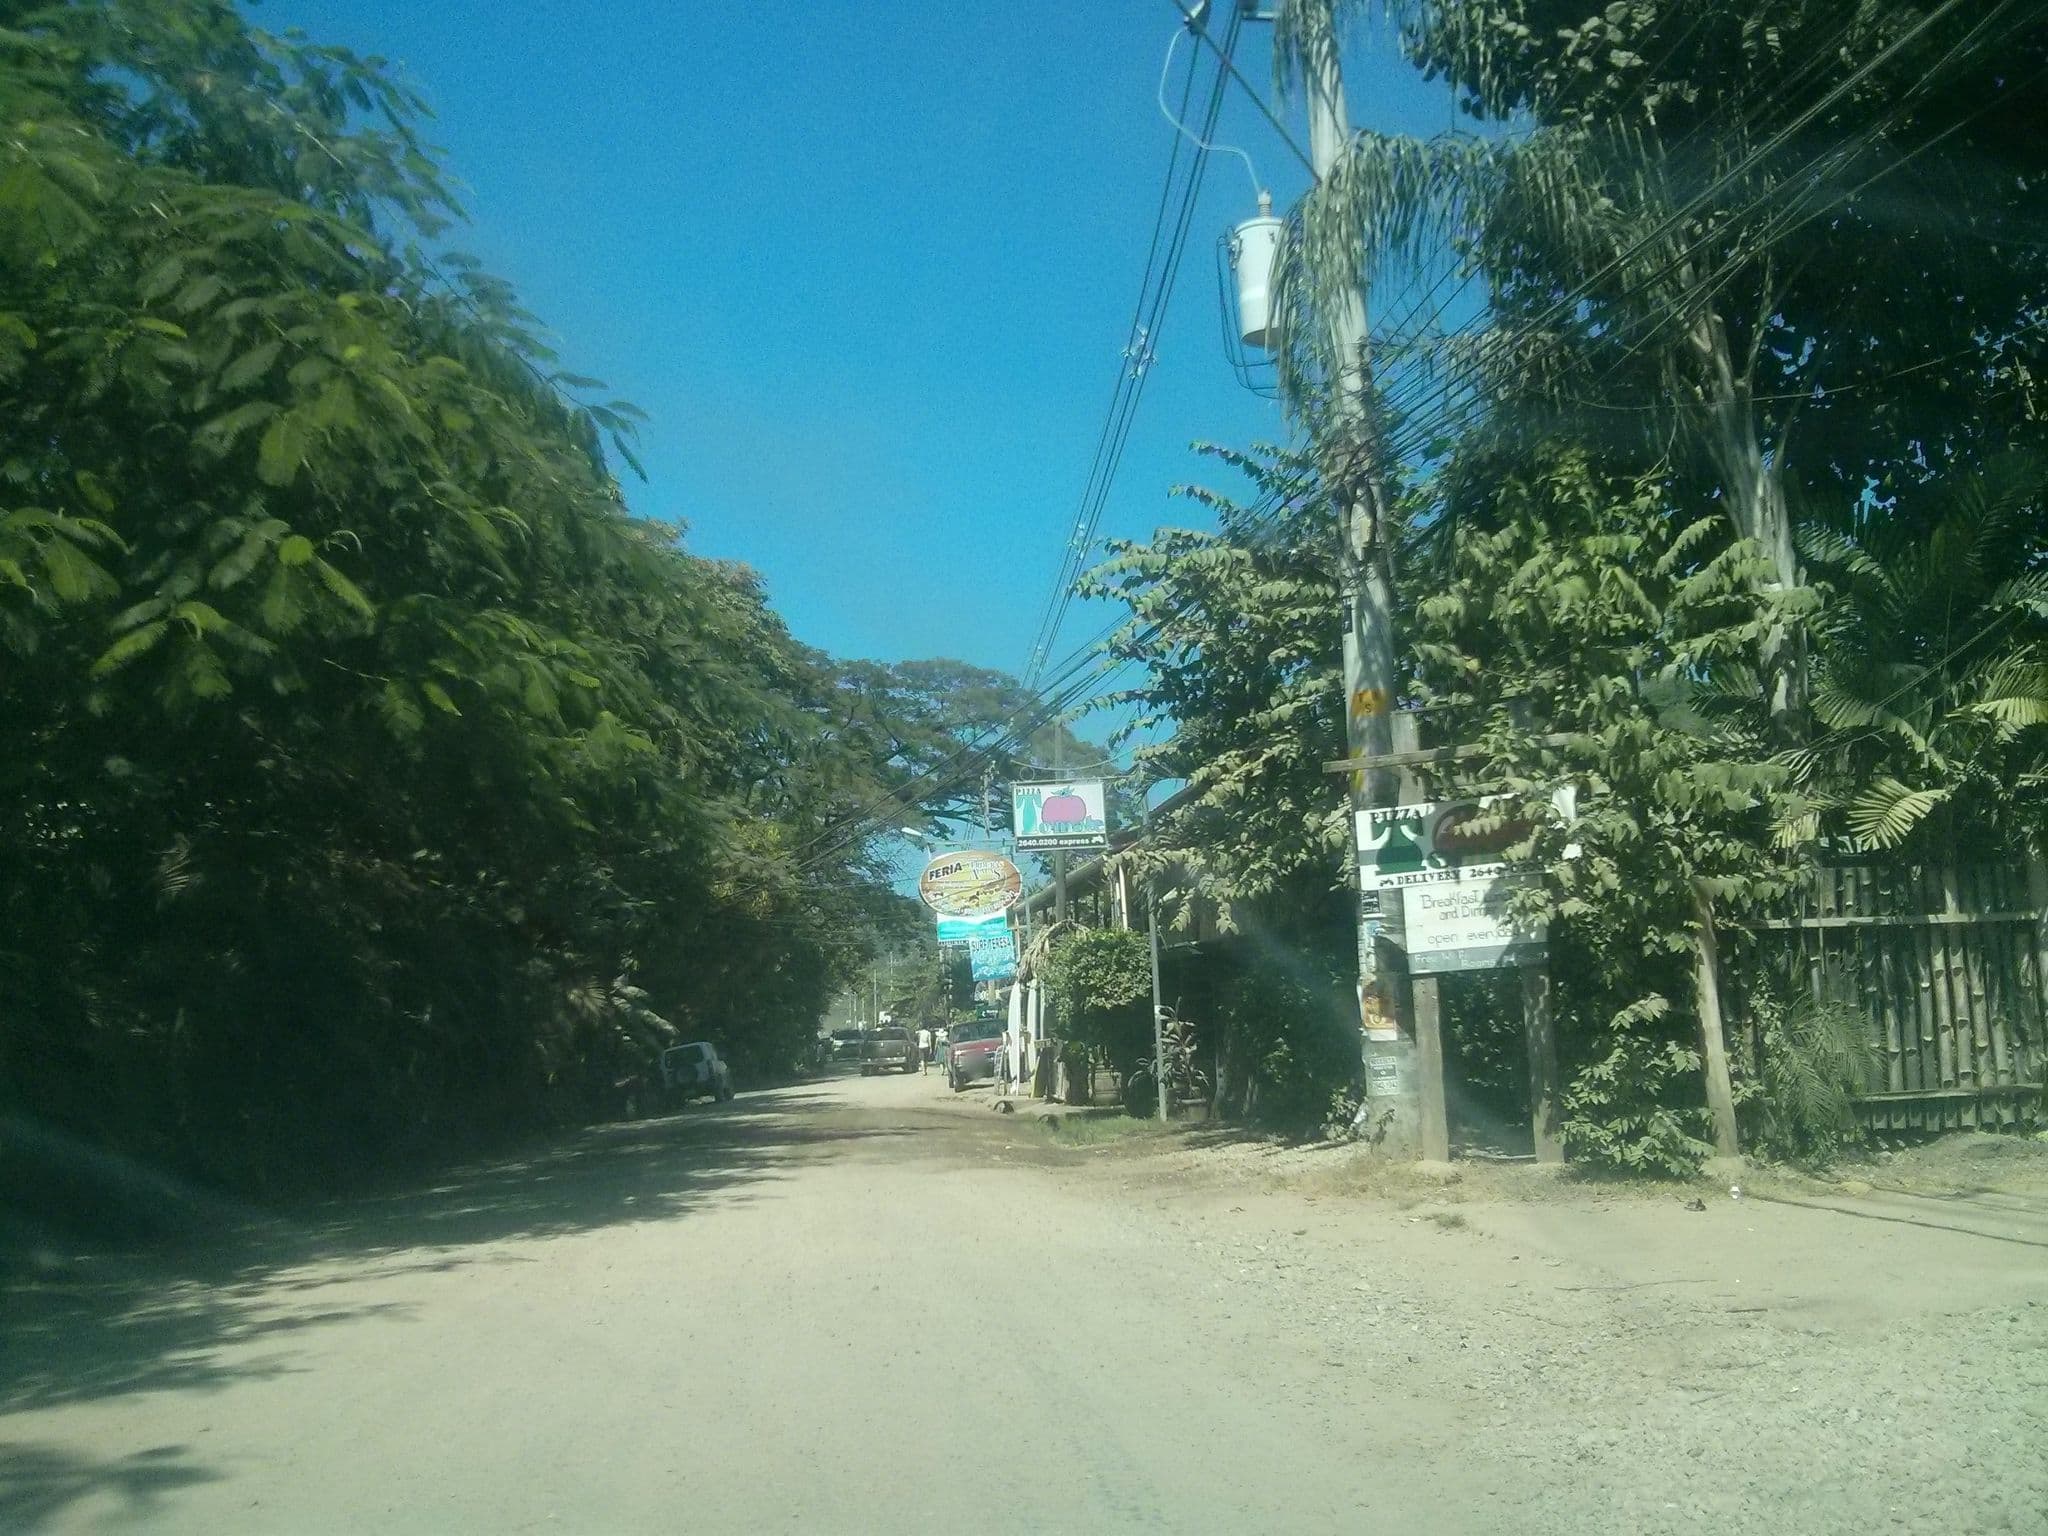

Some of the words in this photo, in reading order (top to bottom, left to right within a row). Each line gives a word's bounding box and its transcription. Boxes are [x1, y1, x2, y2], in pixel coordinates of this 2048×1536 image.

[1371, 808, 1424, 824] PIZZA
[1059, 838, 1090, 846] express
[929, 862, 962, 881] FERIA
[1397, 870, 1461, 885] DELIVERY
[1440, 906, 1458, 921] and
[1428, 933, 1457, 948] open
